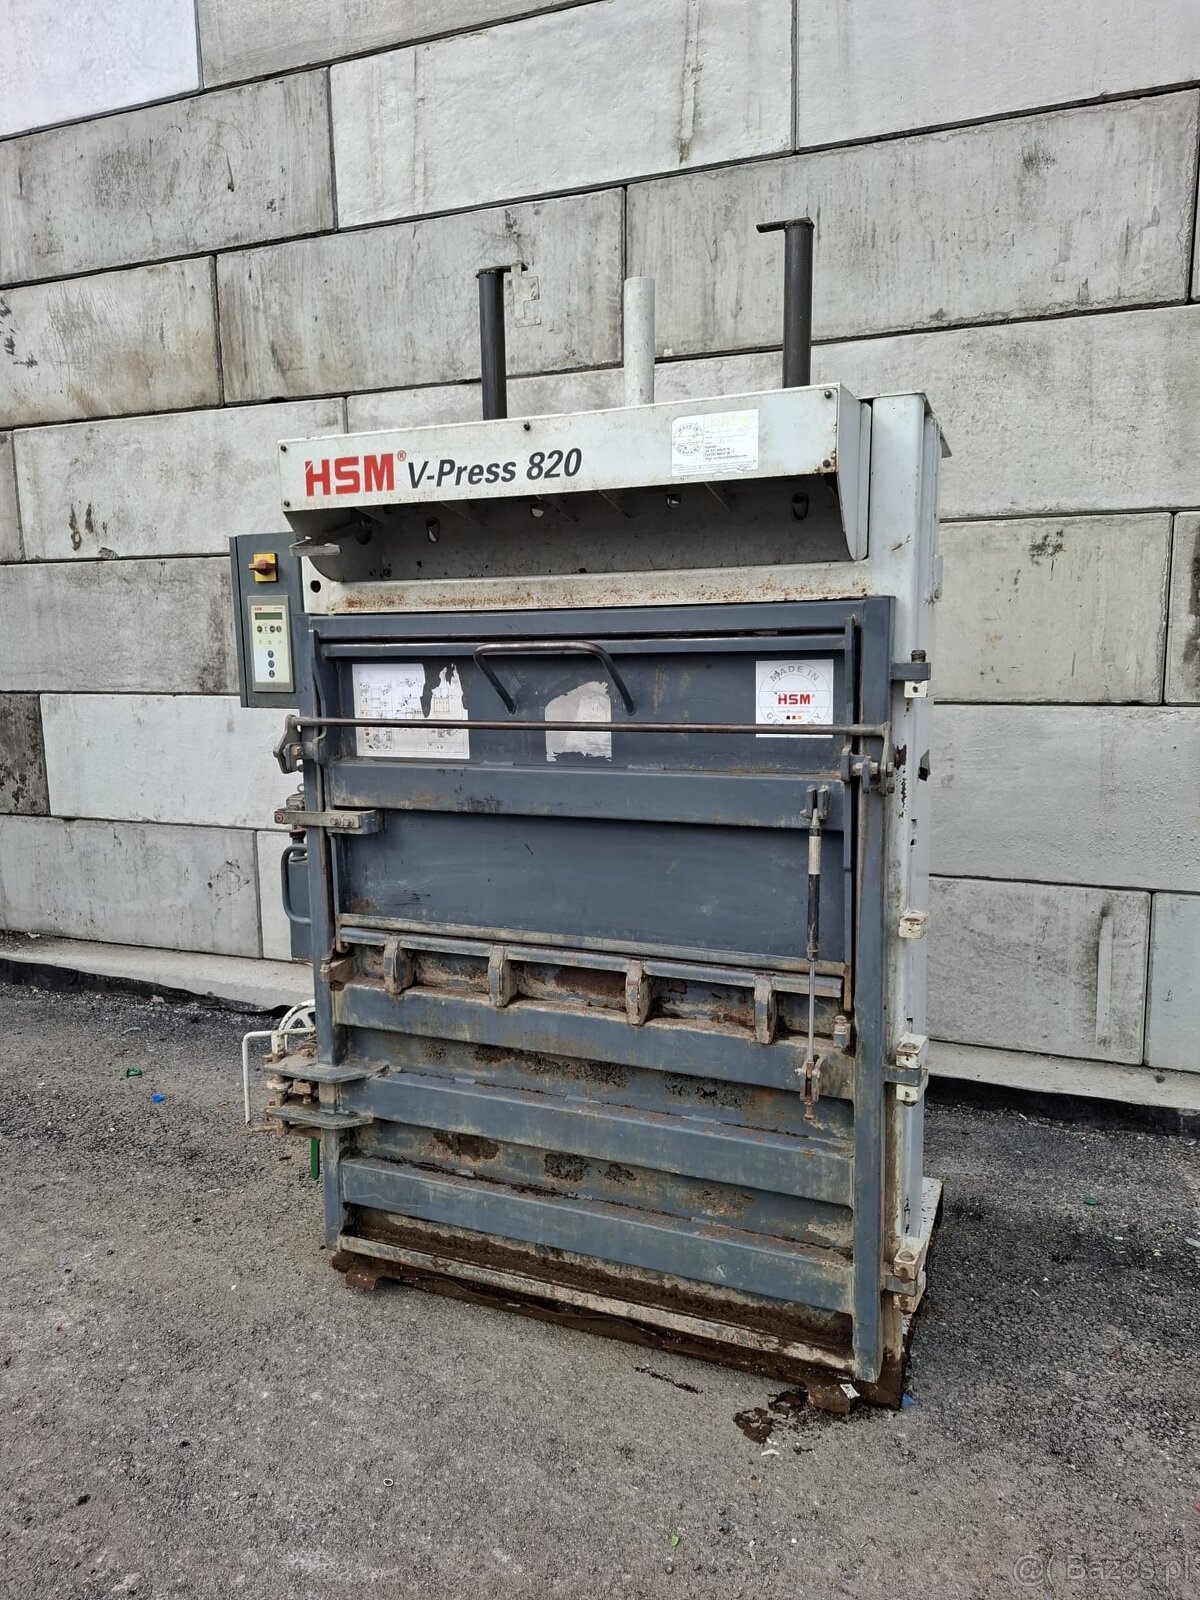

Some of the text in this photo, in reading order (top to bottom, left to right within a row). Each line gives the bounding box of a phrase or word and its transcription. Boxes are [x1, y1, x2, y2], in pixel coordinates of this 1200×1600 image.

[408, 458, 517, 489] V-Press
[526, 448, 582, 480] 820
[770, 666, 820, 681] MADE IN
